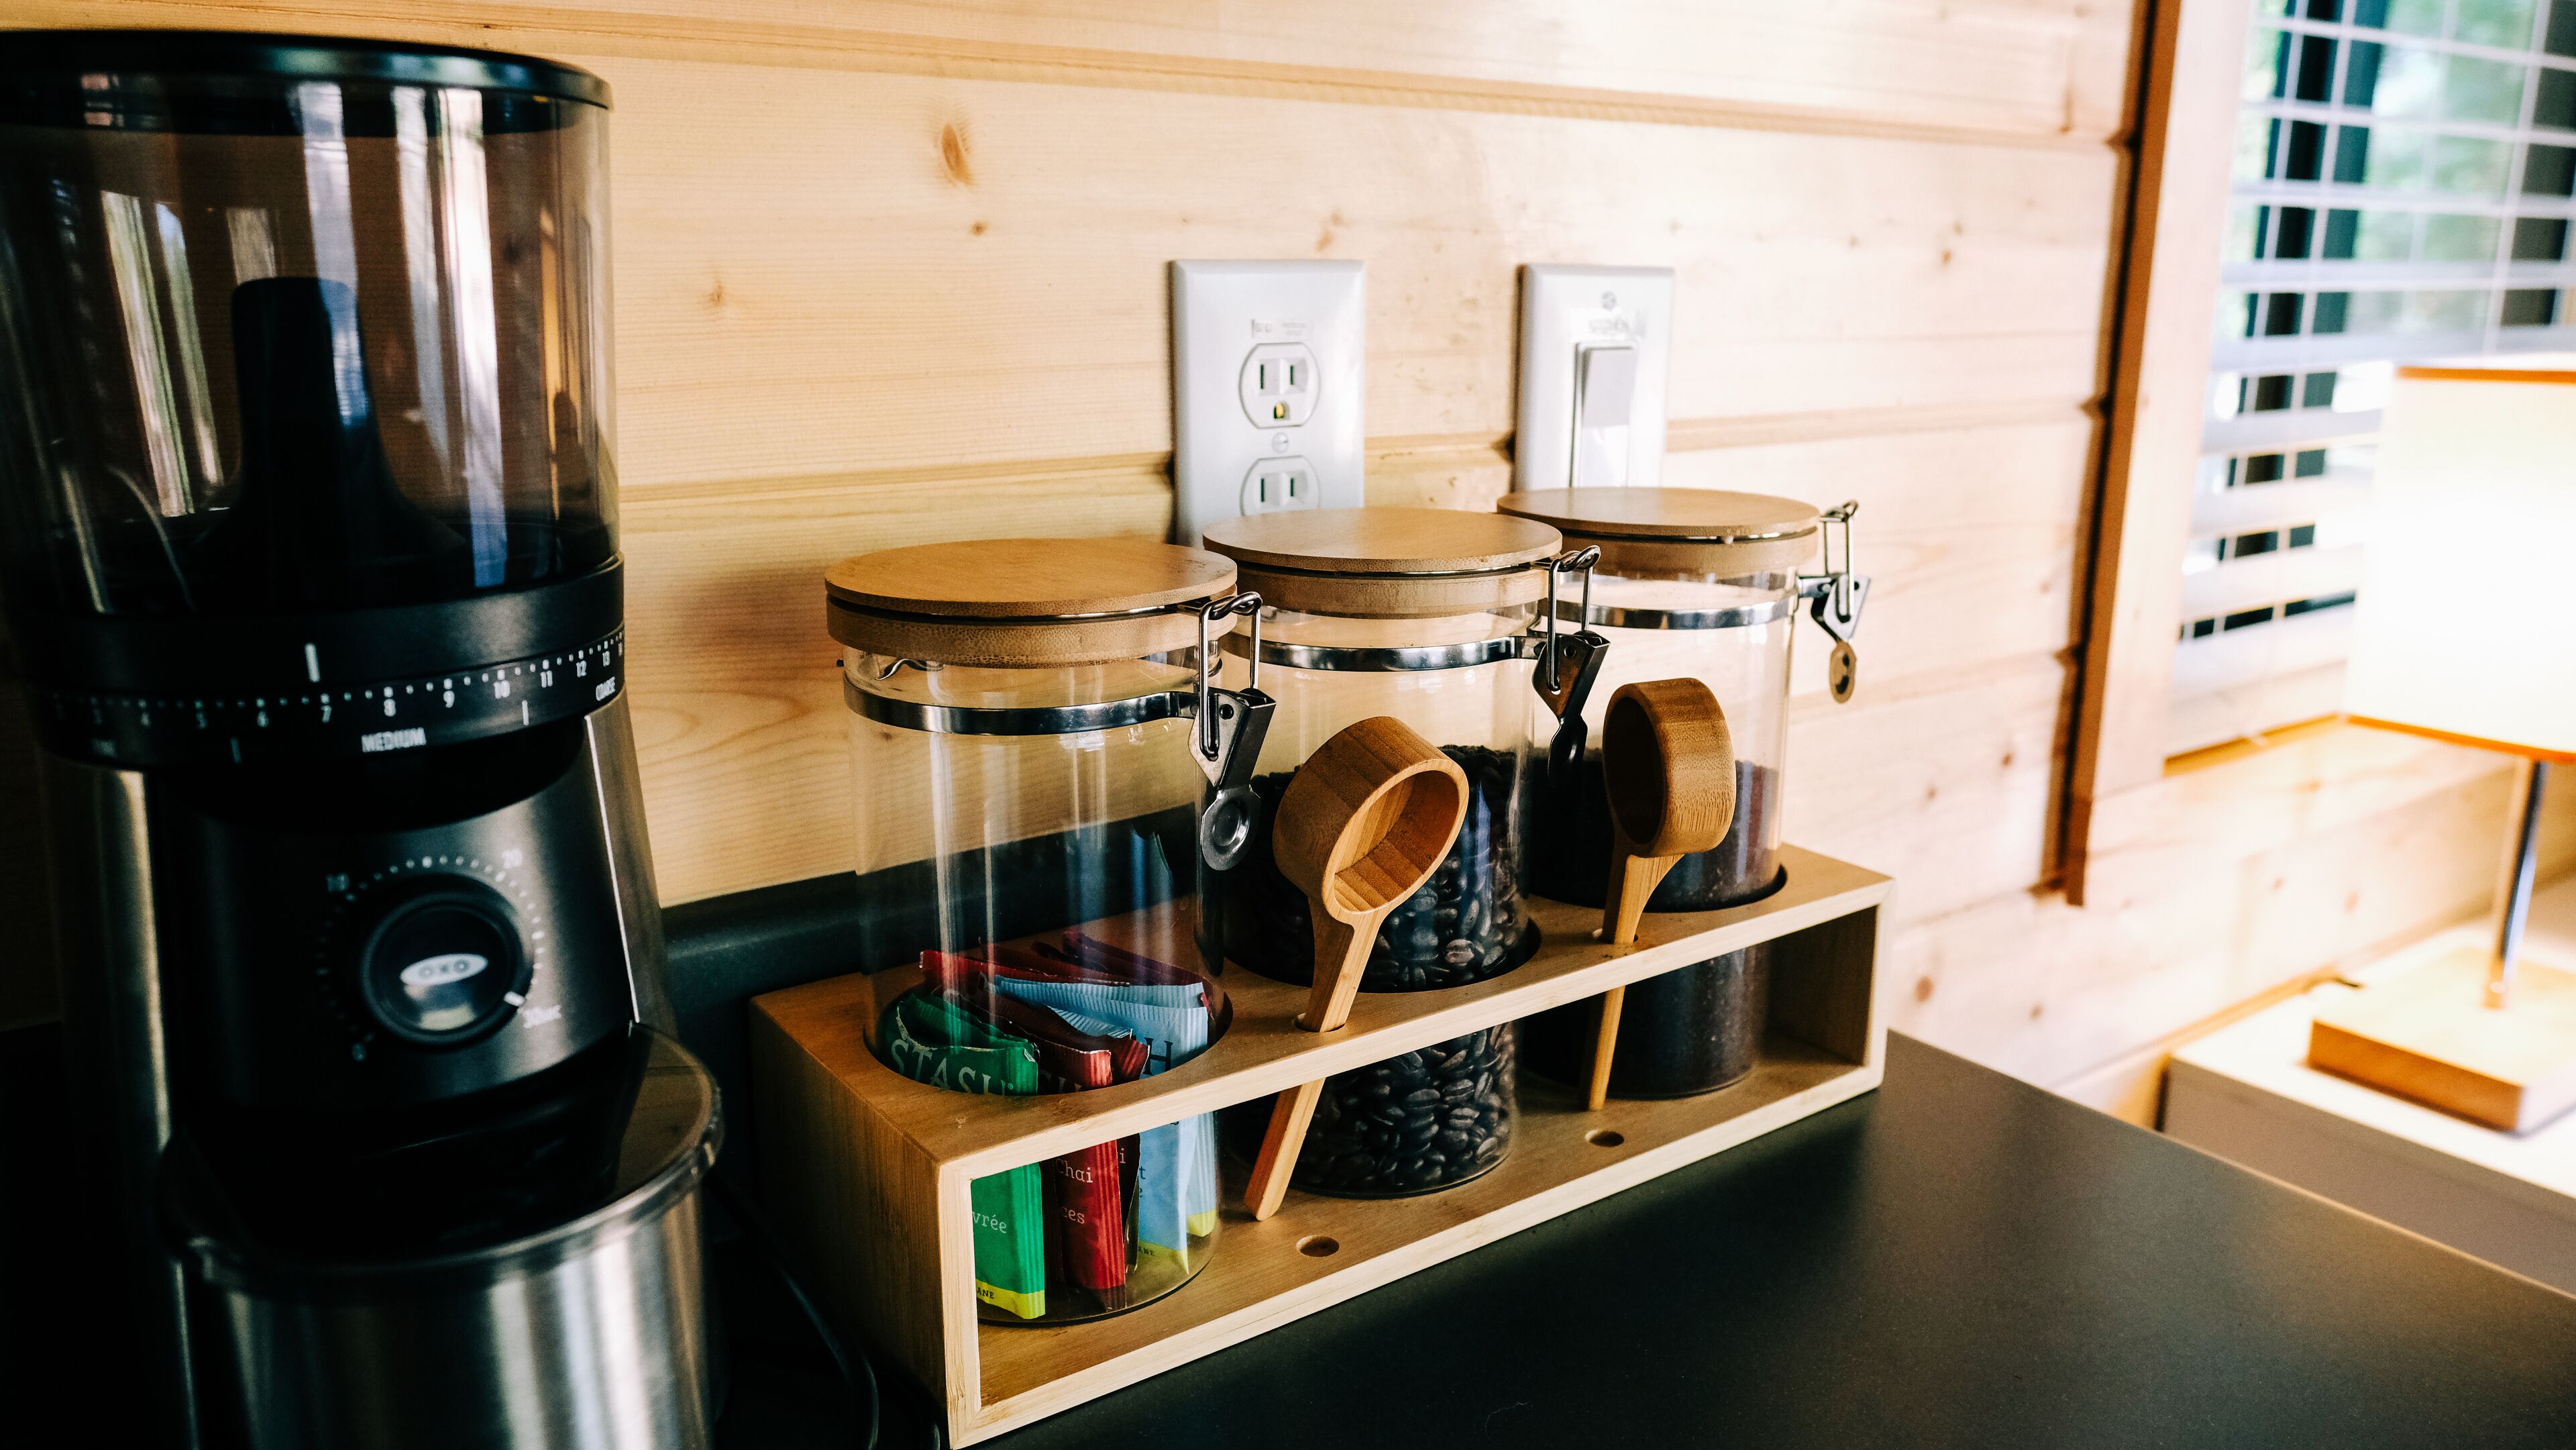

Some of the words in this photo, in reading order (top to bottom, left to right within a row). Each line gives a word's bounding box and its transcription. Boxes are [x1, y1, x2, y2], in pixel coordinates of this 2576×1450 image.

[321, 705, 333, 723] 7
[383, 698, 396, 717] 8
[443, 690, 455, 709] 9
[493, 680, 511, 699] 10
[540, 670, 553, 688] 11
[576, 660, 587, 678] 12
[361, 727, 427, 752] MEDIUM
[1055, 1157, 1093, 1183] Chai
